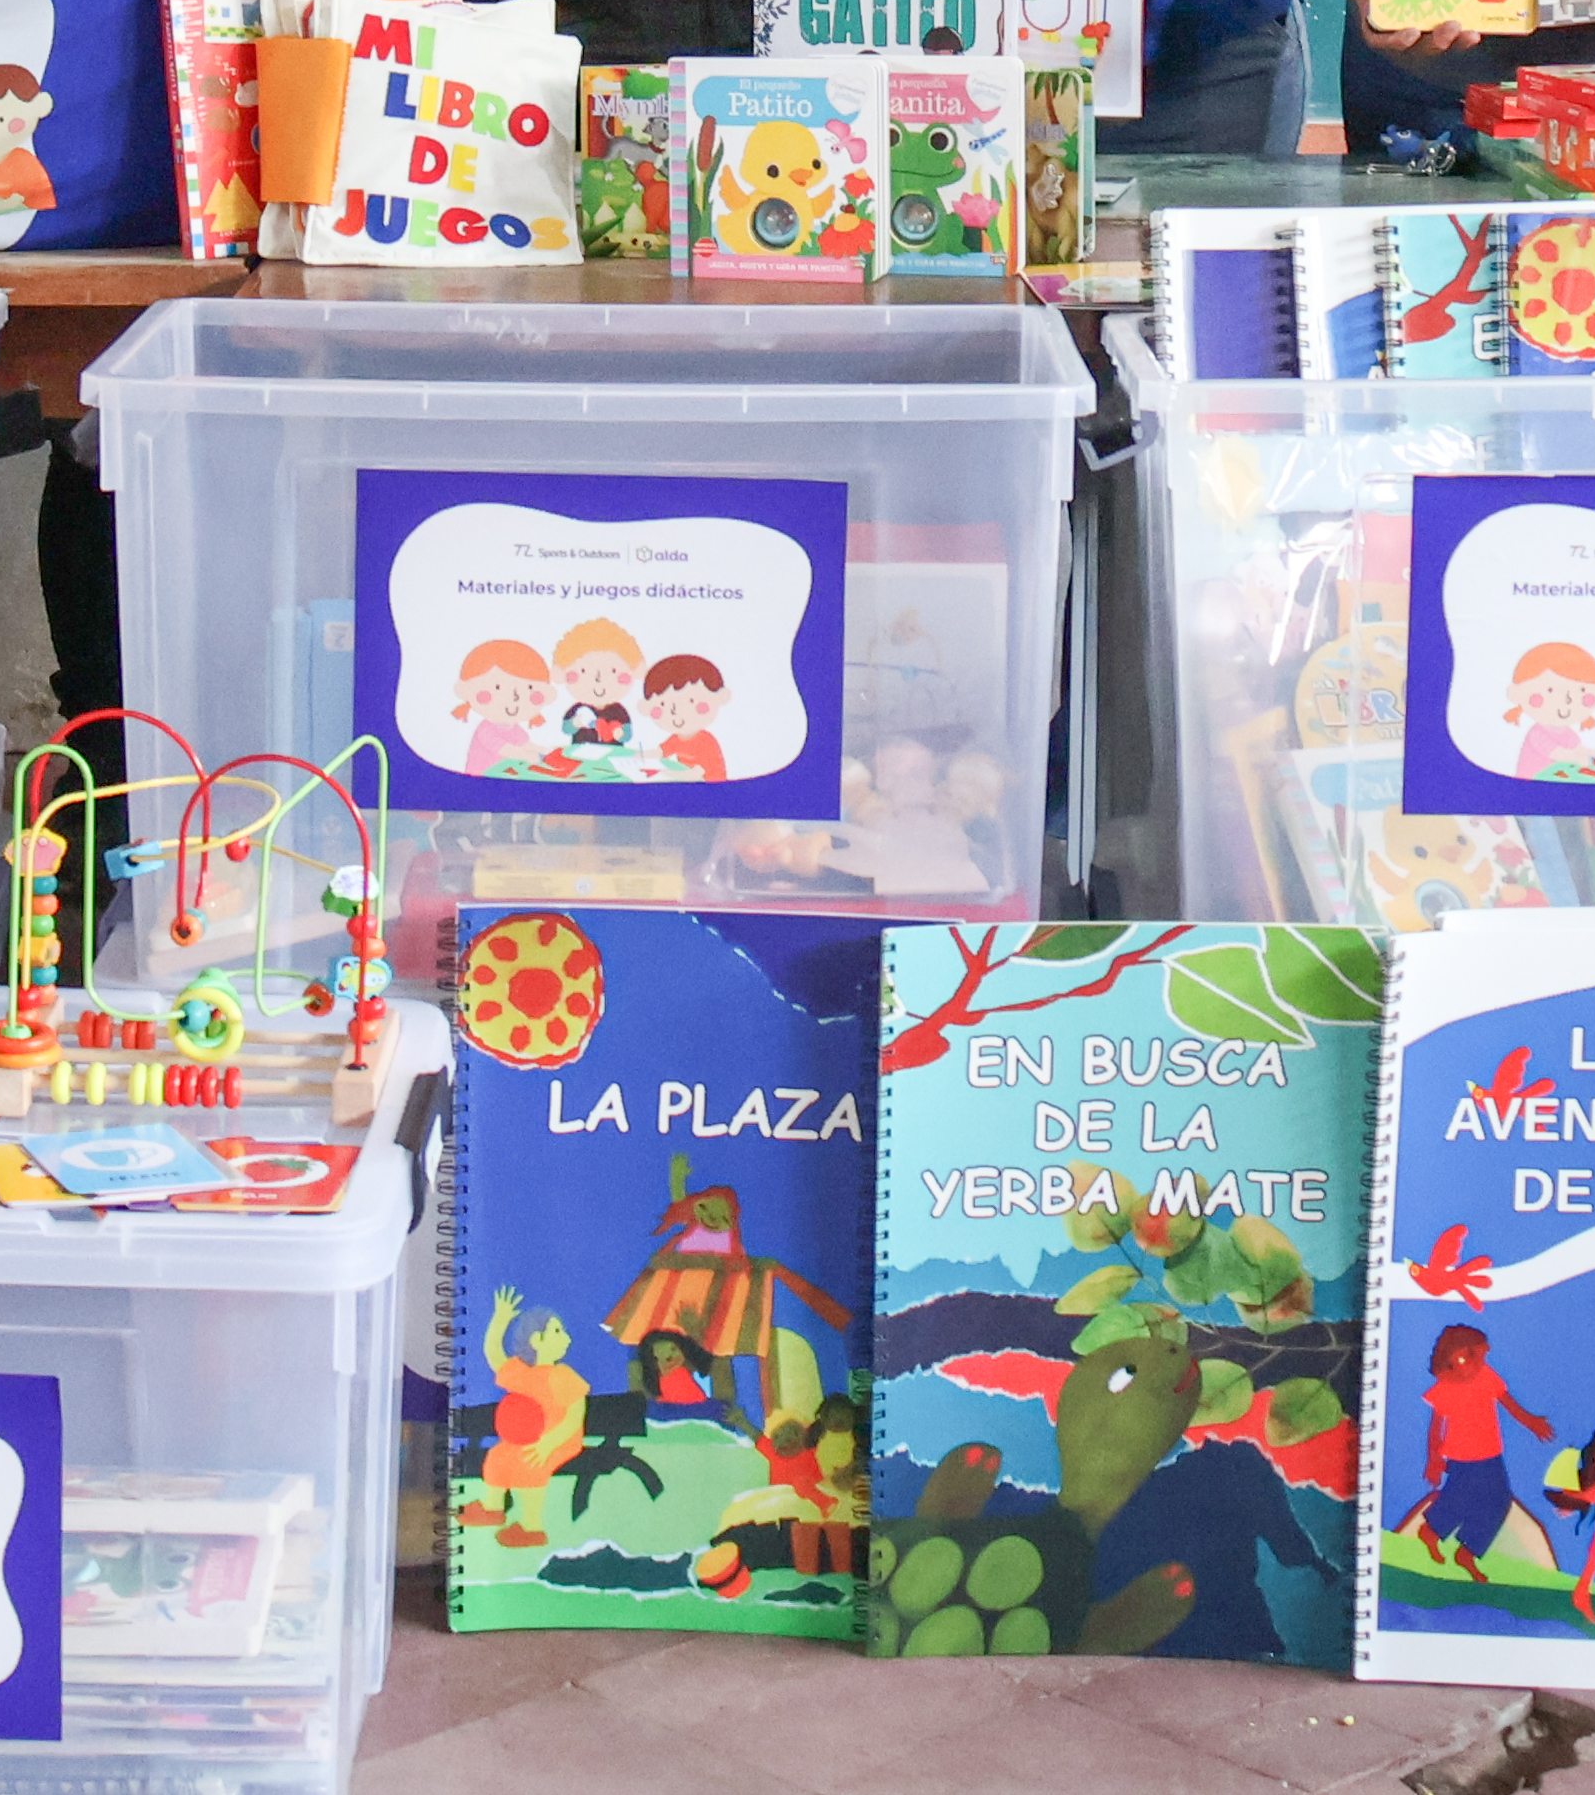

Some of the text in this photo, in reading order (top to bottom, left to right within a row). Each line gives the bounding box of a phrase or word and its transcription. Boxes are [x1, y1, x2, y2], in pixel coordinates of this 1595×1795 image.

[354, 14, 435, 70] MI
[384, 71, 550, 147] LIBRO
[728, 92, 814, 118] Patito
[890, 91, 966, 115] anita
[408, 135, 478, 193] DE
[333, 188, 569, 250] JUEGOS
[654, 549, 688, 561] alda
[458, 580, 743, 600] Materiales y juegos didácticos
[967, 1035, 1287, 1089] EN BUSCA
[547, 1080, 863, 1144] LA PLAZA
[1035, 1101, 1218, 1153] DE LA
[922, 1167, 1328, 1222] YERBA MATE
[1514, 1168, 1593, 1213] DE
